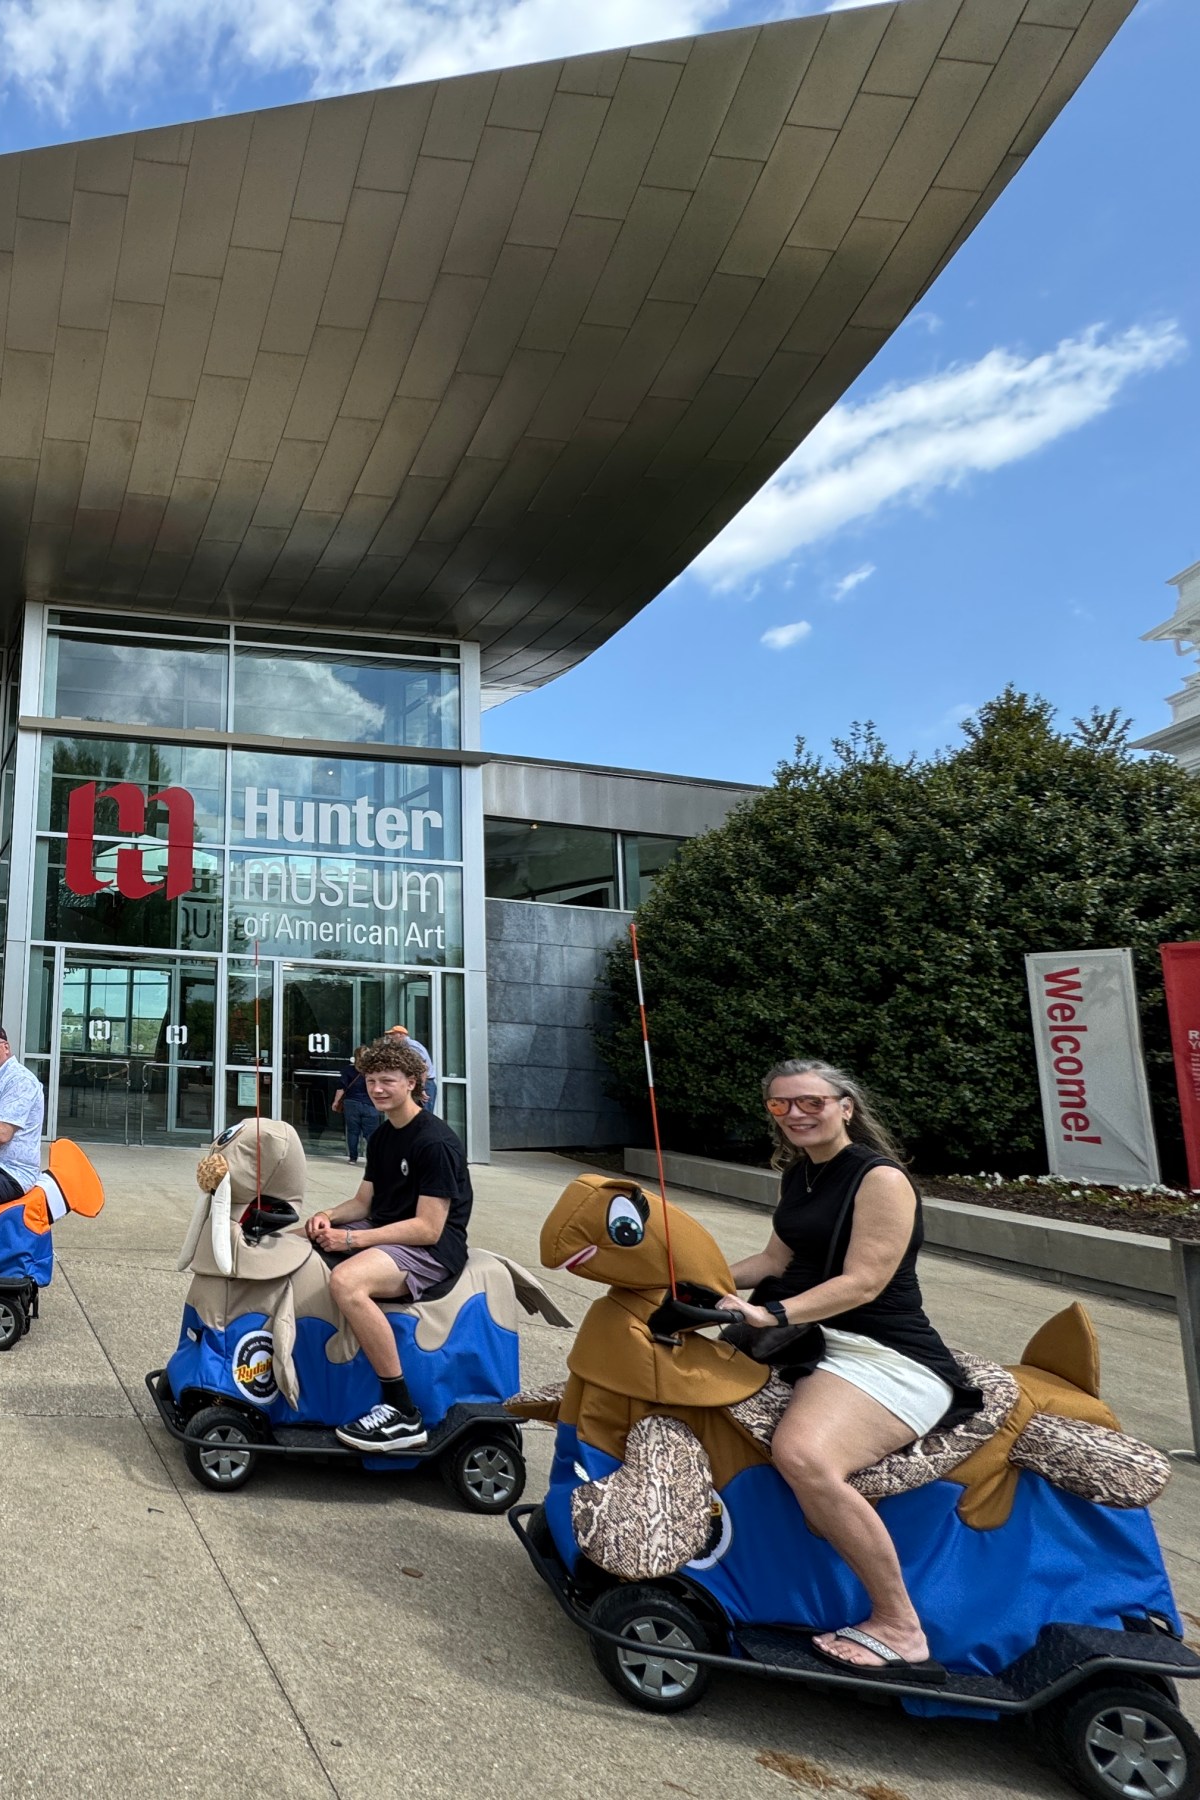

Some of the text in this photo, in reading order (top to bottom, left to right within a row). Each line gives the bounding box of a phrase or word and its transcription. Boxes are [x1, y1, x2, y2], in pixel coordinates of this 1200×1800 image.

[244, 786, 443, 851] Hunter
[243, 912, 269, 939] of
[275, 913, 399, 947] American
[404, 921, 446, 950] Art
[1043, 967, 1102, 1145] Welcome!
